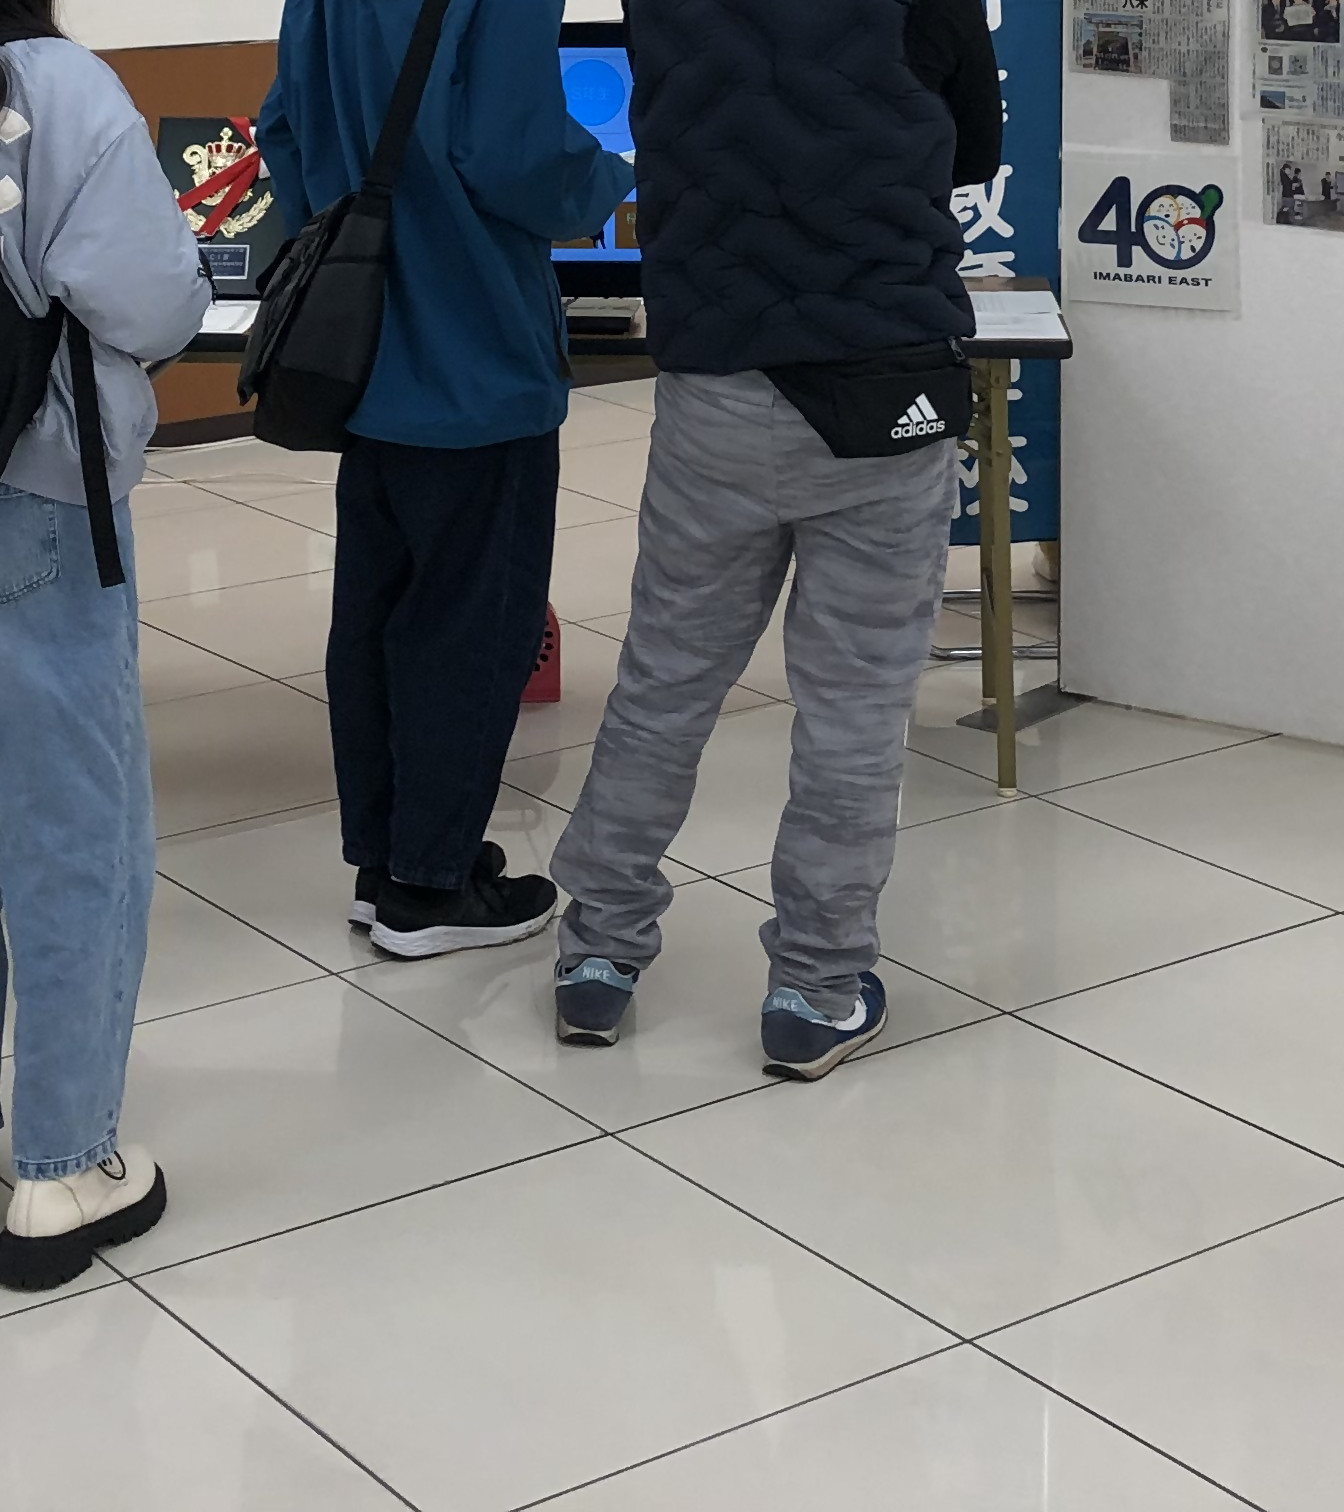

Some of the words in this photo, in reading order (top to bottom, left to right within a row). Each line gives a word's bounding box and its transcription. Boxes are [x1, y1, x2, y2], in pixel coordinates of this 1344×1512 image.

[1093, 271, 1162, 284] IMABARI
[1168, 276, 1213, 287] EAST
[891, 419, 946, 439] adidas
[582, 966, 610, 980] NIKE
[773, 996, 798, 1011] NIKE
